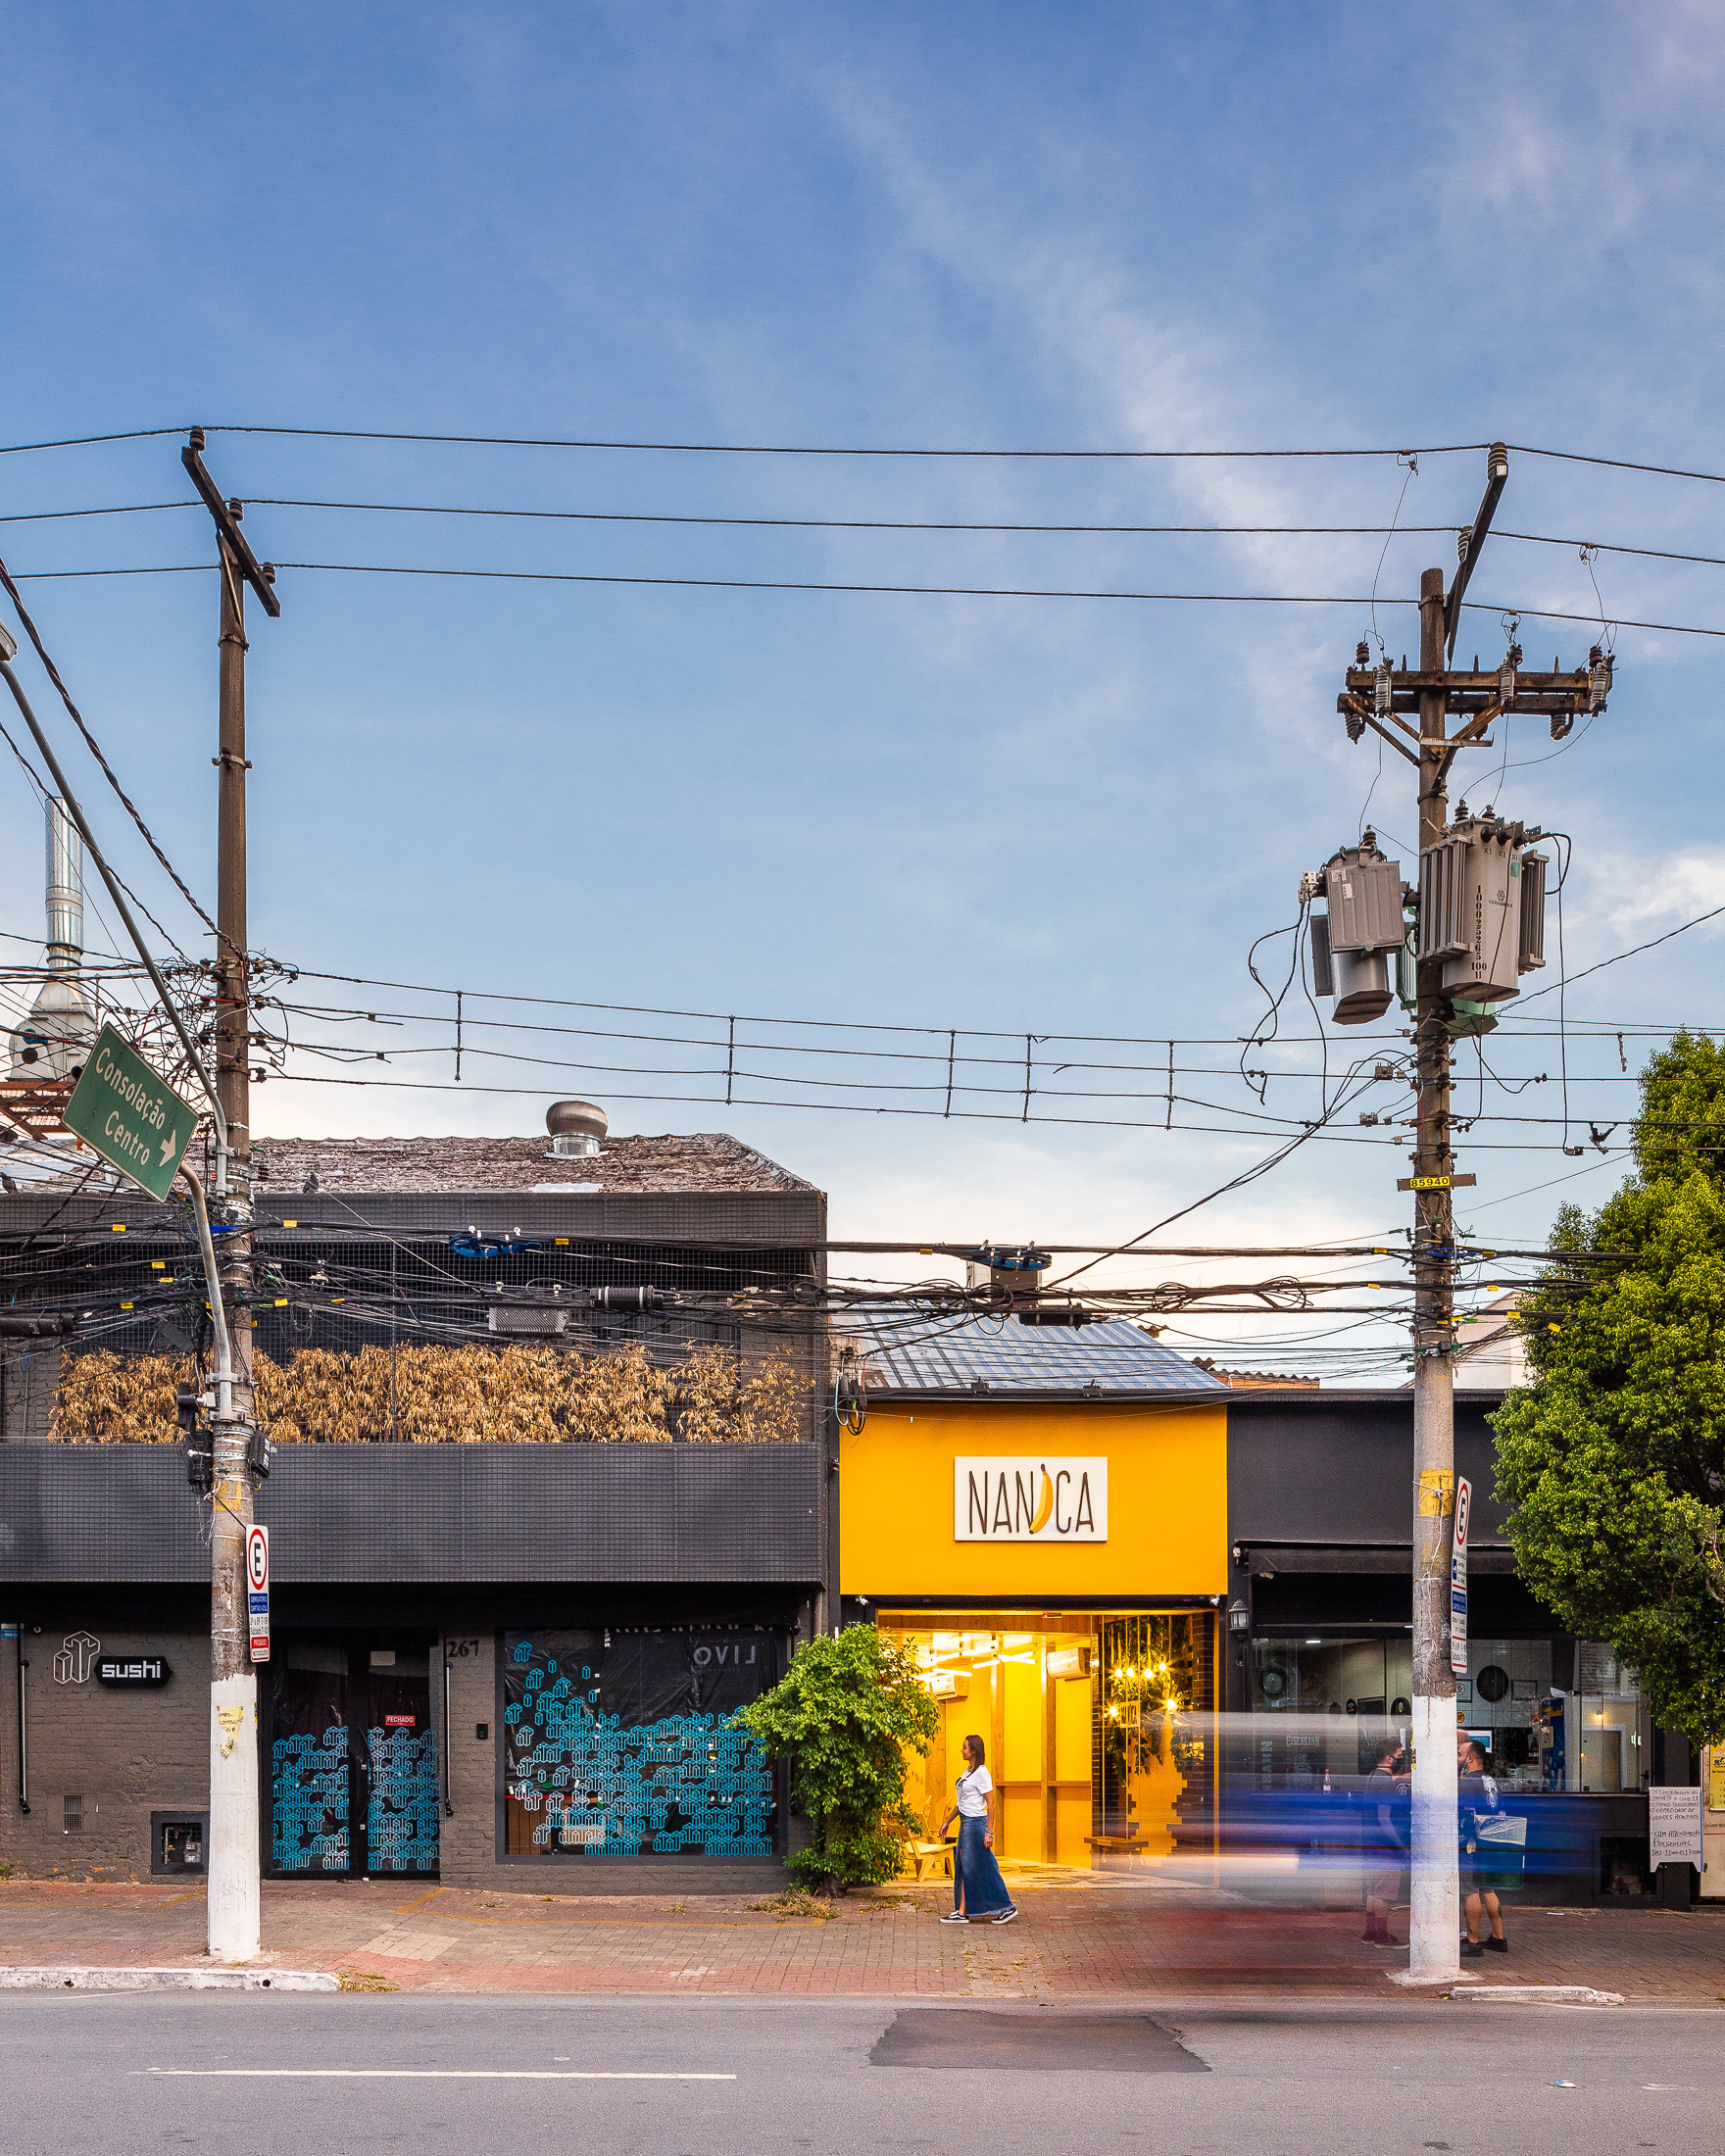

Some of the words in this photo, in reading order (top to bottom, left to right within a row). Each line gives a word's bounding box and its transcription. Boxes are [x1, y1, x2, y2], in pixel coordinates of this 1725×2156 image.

[95, 1047, 166, 1130] Consolação
[105, 1110, 150, 1165] Centro
[1410, 1177, 1449, 1188] 85940
[1458, 1496, 1466, 1534] E
[254, 1543, 262, 1577] E
[447, 1640, 479, 1657] 267
[102, 1660, 161, 1678] sushi
